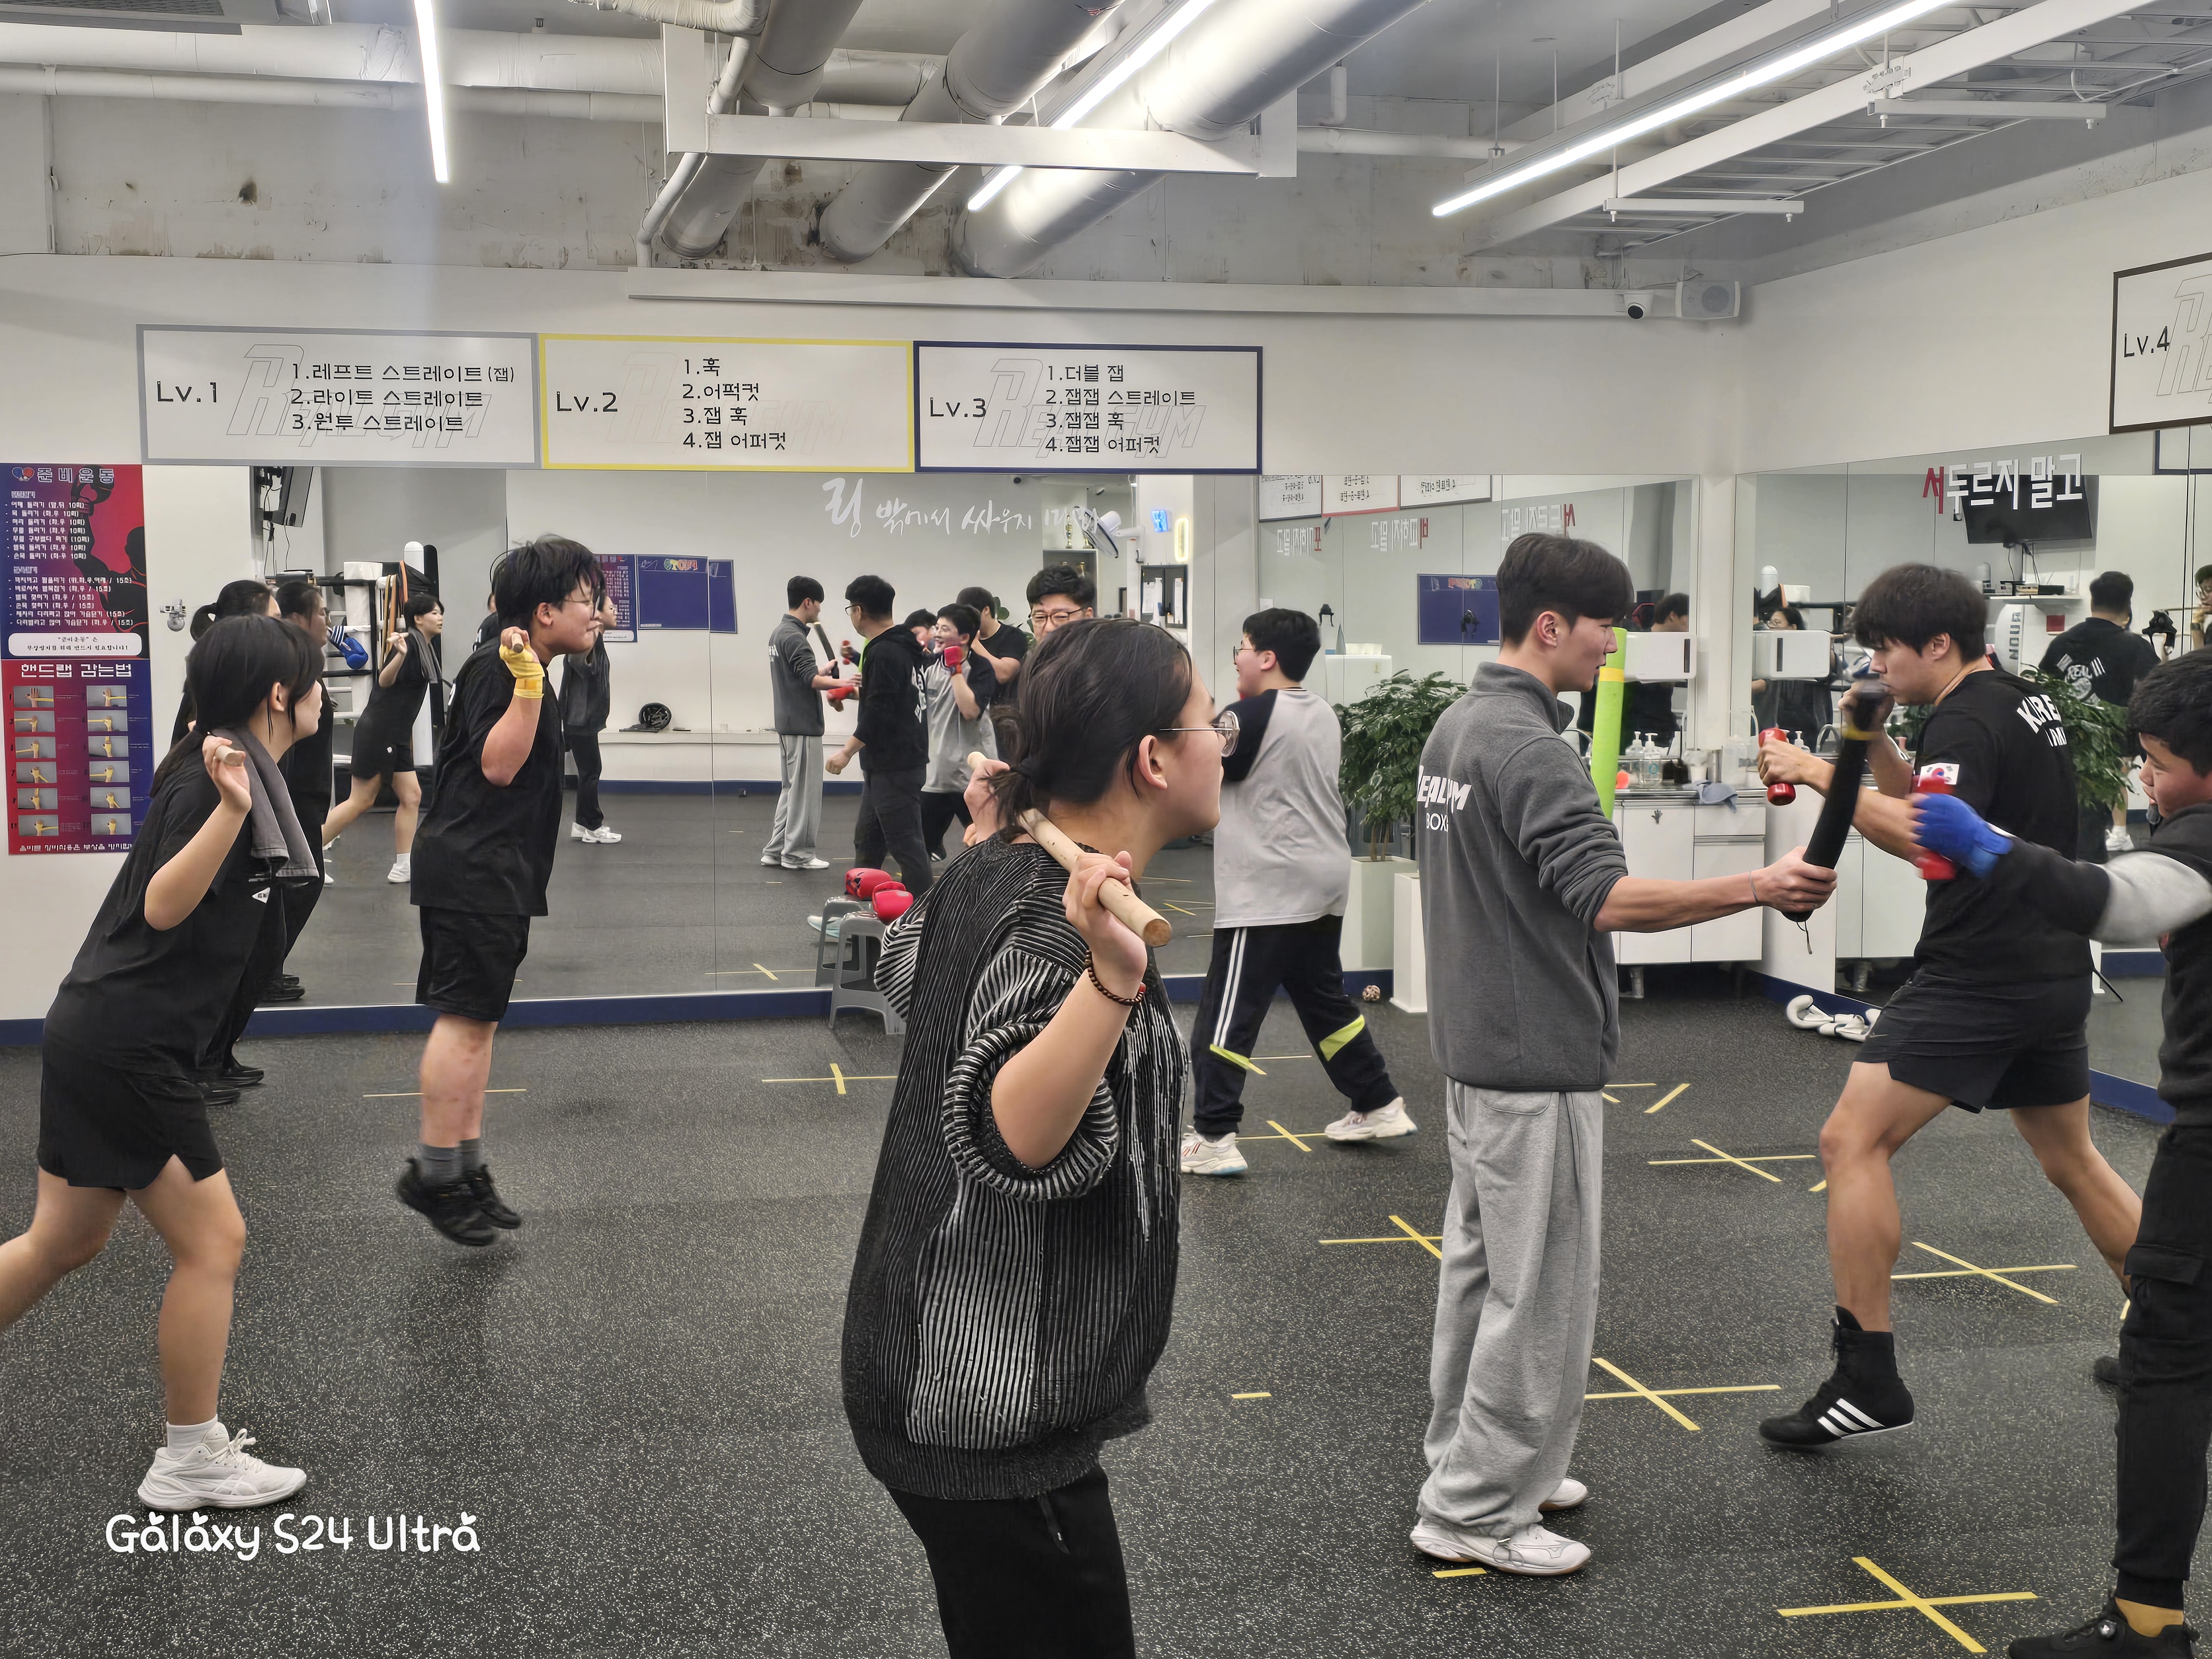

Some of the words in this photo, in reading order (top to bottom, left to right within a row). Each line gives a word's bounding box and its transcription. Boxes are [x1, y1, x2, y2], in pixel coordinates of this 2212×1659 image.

[2124, 326, 2170, 358] Lv.4
[293, 363, 373, 380] 1.레프트
[382, 366, 482, 382] 스트레이트
[685, 357, 721, 377] 1.훅
[1048, 364, 1099, 382] 1.더블
[1107, 364, 1123, 382] 잽
[156, 380, 217, 403] Lv.1
[291, 388, 373, 406] 2.라이트
[383, 390, 483, 408] 스트레이트
[556, 391, 618, 412] Lv.2
[682, 383, 759, 401] 2.어퍽컷
[1046, 388, 1099, 405] 2.잽잽
[1107, 390, 1196, 406] 스트레이트
[683, 406, 721, 425] 3.잽
[730, 406, 748, 426] 훅
[930, 397, 987, 418] Lv.3
[292, 412, 354, 431] 3.원투
[363, 415, 463, 432] 스트레이트
[1046, 411, 1099, 429] 3.잽잽
[1108, 412, 1124, 430] 훅
[683, 431, 722, 449] 4.잽
[731, 432, 785, 450] 어퍼컷
[1045, 435, 1099, 453] 4.잽잽
[1108, 436, 1159, 453] 어퍼컷
[1922, 459, 2020, 514] 서두르지
[2031, 453, 2082, 509] 말고
[822, 477, 863, 538] 링
[961, 499, 1031, 534] 싸우지
[81, 664, 132, 677] 감는법
